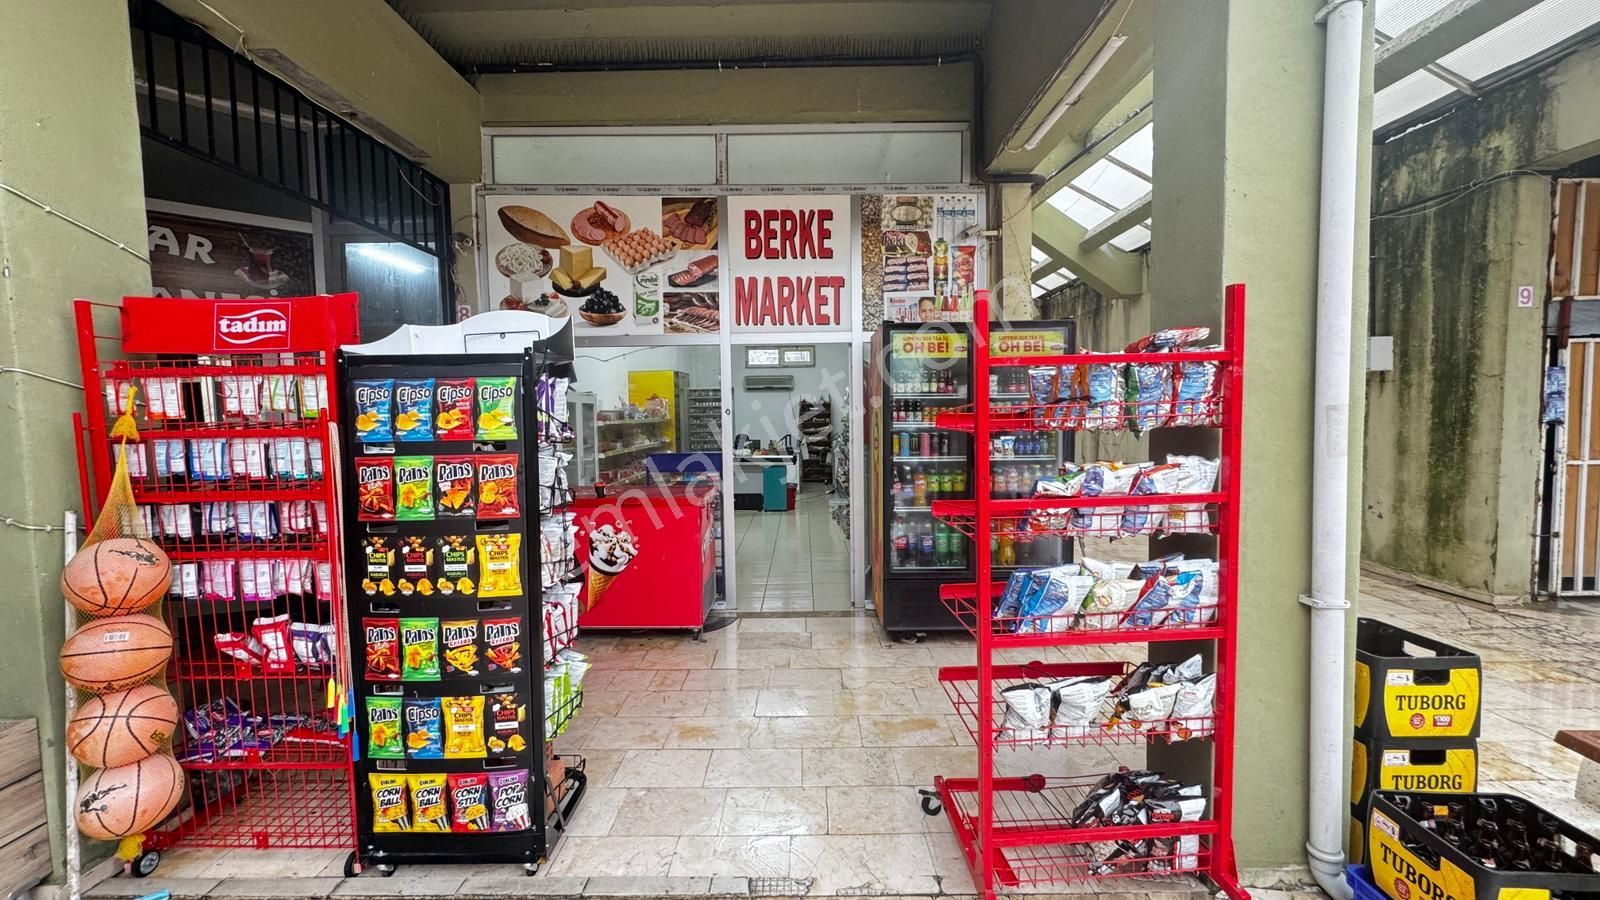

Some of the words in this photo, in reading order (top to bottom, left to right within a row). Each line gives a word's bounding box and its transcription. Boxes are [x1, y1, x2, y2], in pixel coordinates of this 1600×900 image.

[744, 209, 833, 260] BERKE
[734, 276, 845, 326] MARKET
[1519, 287, 1532, 305] 9
[218, 316, 287, 333] tadım
[903, 342, 923, 353] OH
[927, 342, 949, 353] BE!
[998, 341, 1020, 353] OH
[1023, 340, 1045, 352] BE!
[357, 387, 390, 406] Cipso
[398, 387, 431, 406] Cipso
[439, 385, 471, 404] Cipso
[480, 385, 512, 403] Cipso
[1395, 694, 1466, 711] TUBORG
[408, 706, 439, 723] Cipso
[500, 784, 520, 796] POP
[1391, 774, 1463, 791] TUBORG
[376, 787, 401, 798] CORN
[415, 786, 441, 798] CORN
[455, 785, 482, 798] CORN
[380, 798, 401, 808] BALL
[419, 797, 441, 807] BALL
[457, 795, 480, 808] STIX
[495, 793, 523, 808] CORN
[1380, 841, 1457, 900] TUBOR
